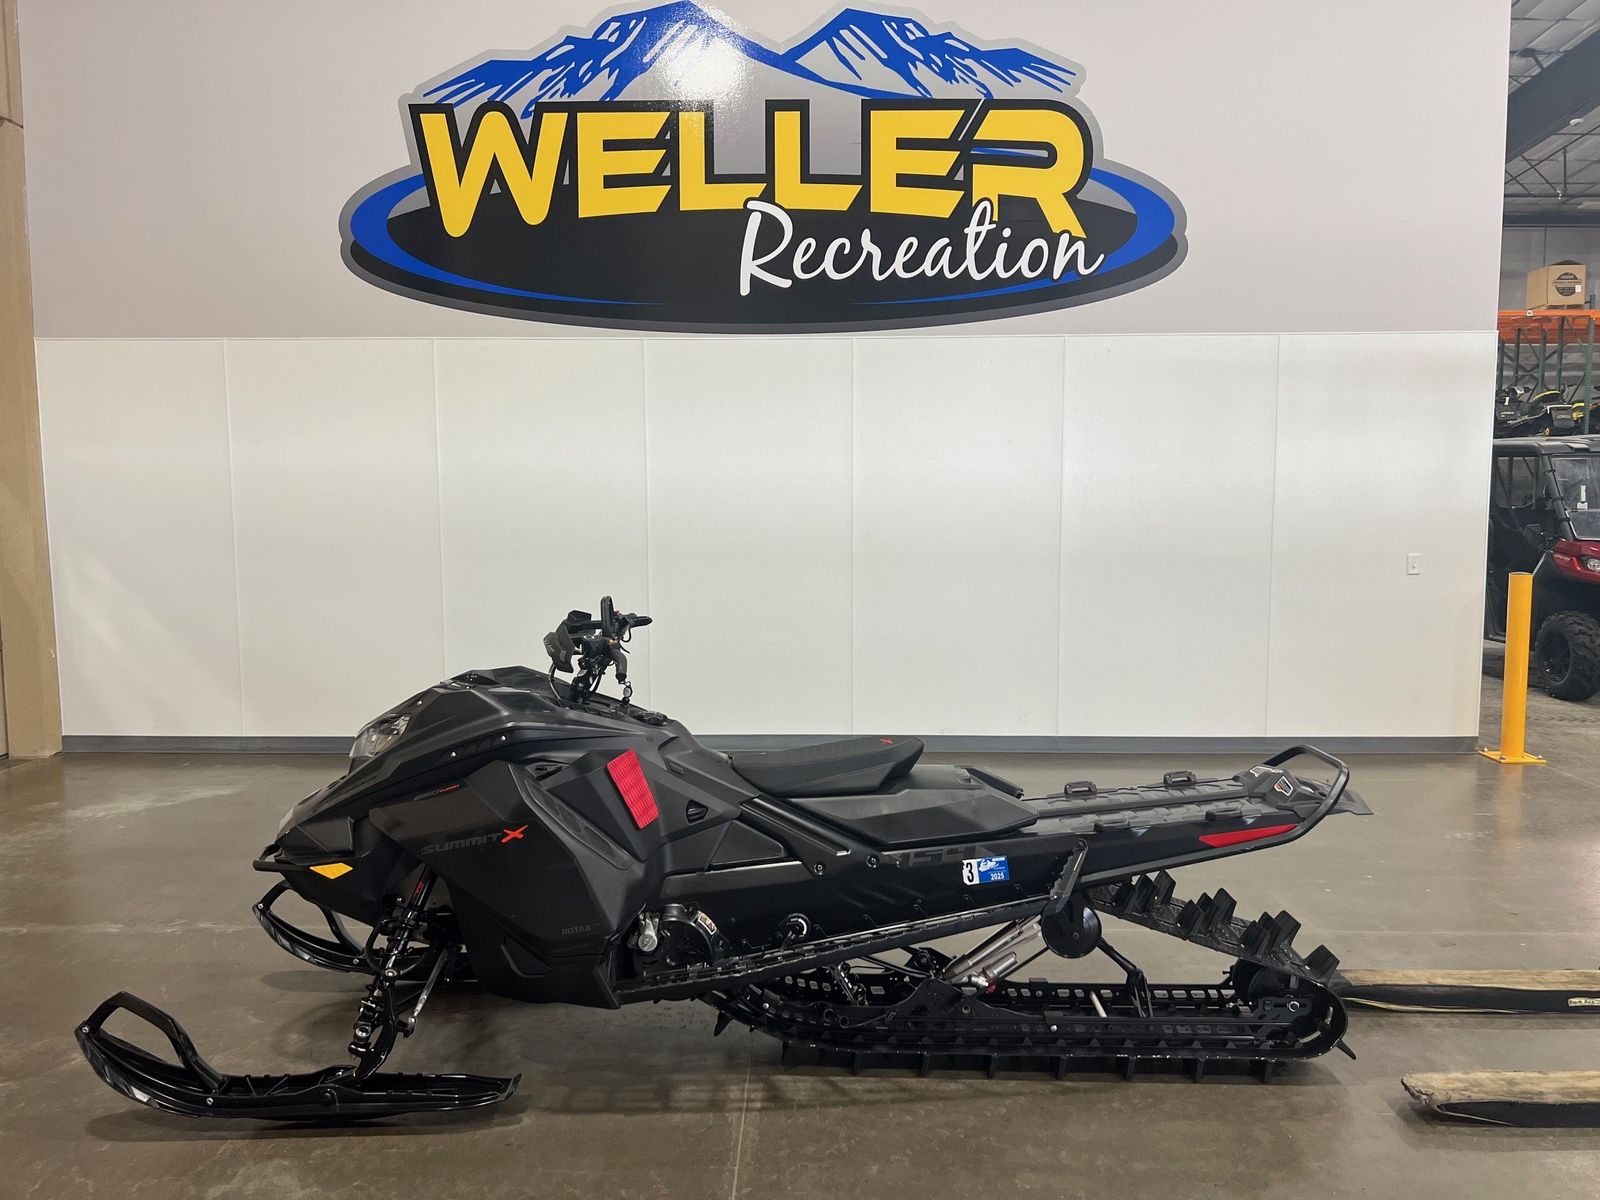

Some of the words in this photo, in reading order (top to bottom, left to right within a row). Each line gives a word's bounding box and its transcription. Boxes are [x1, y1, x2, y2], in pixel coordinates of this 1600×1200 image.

[420, 109, 1085, 237] WELLER
[740, 199, 1104, 296] Recreation
[500, 824, 529, 844] X
[966, 862, 974, 882] 3
[990, 872, 1005, 881] 2025
